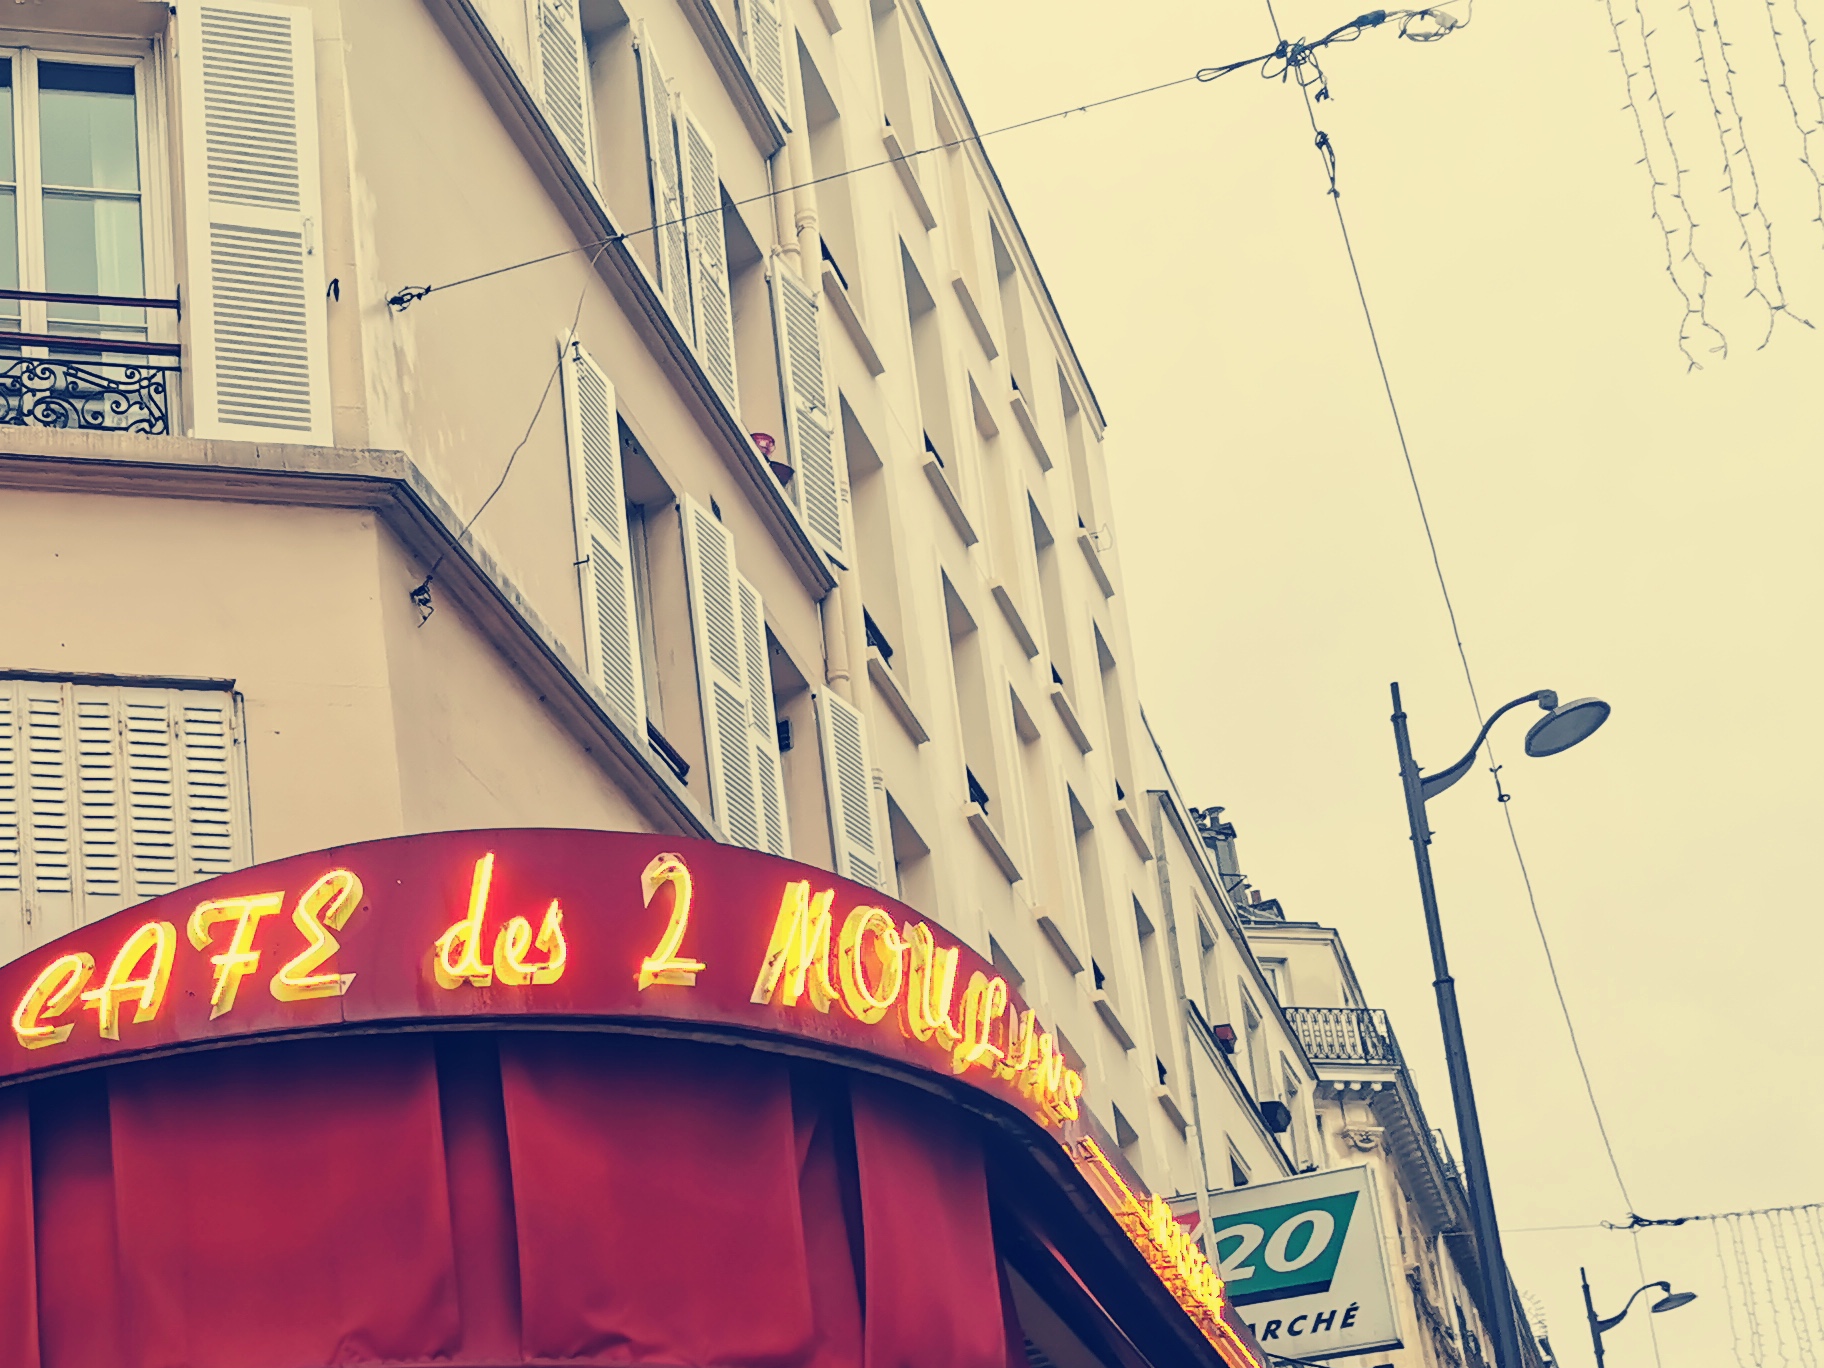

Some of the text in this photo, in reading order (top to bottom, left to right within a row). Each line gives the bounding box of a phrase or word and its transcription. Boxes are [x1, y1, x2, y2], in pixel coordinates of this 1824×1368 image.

[434, 852, 566, 988] des
[638, 852, 706, 988] 2
[750, 879, 1083, 1129] MOULINS
